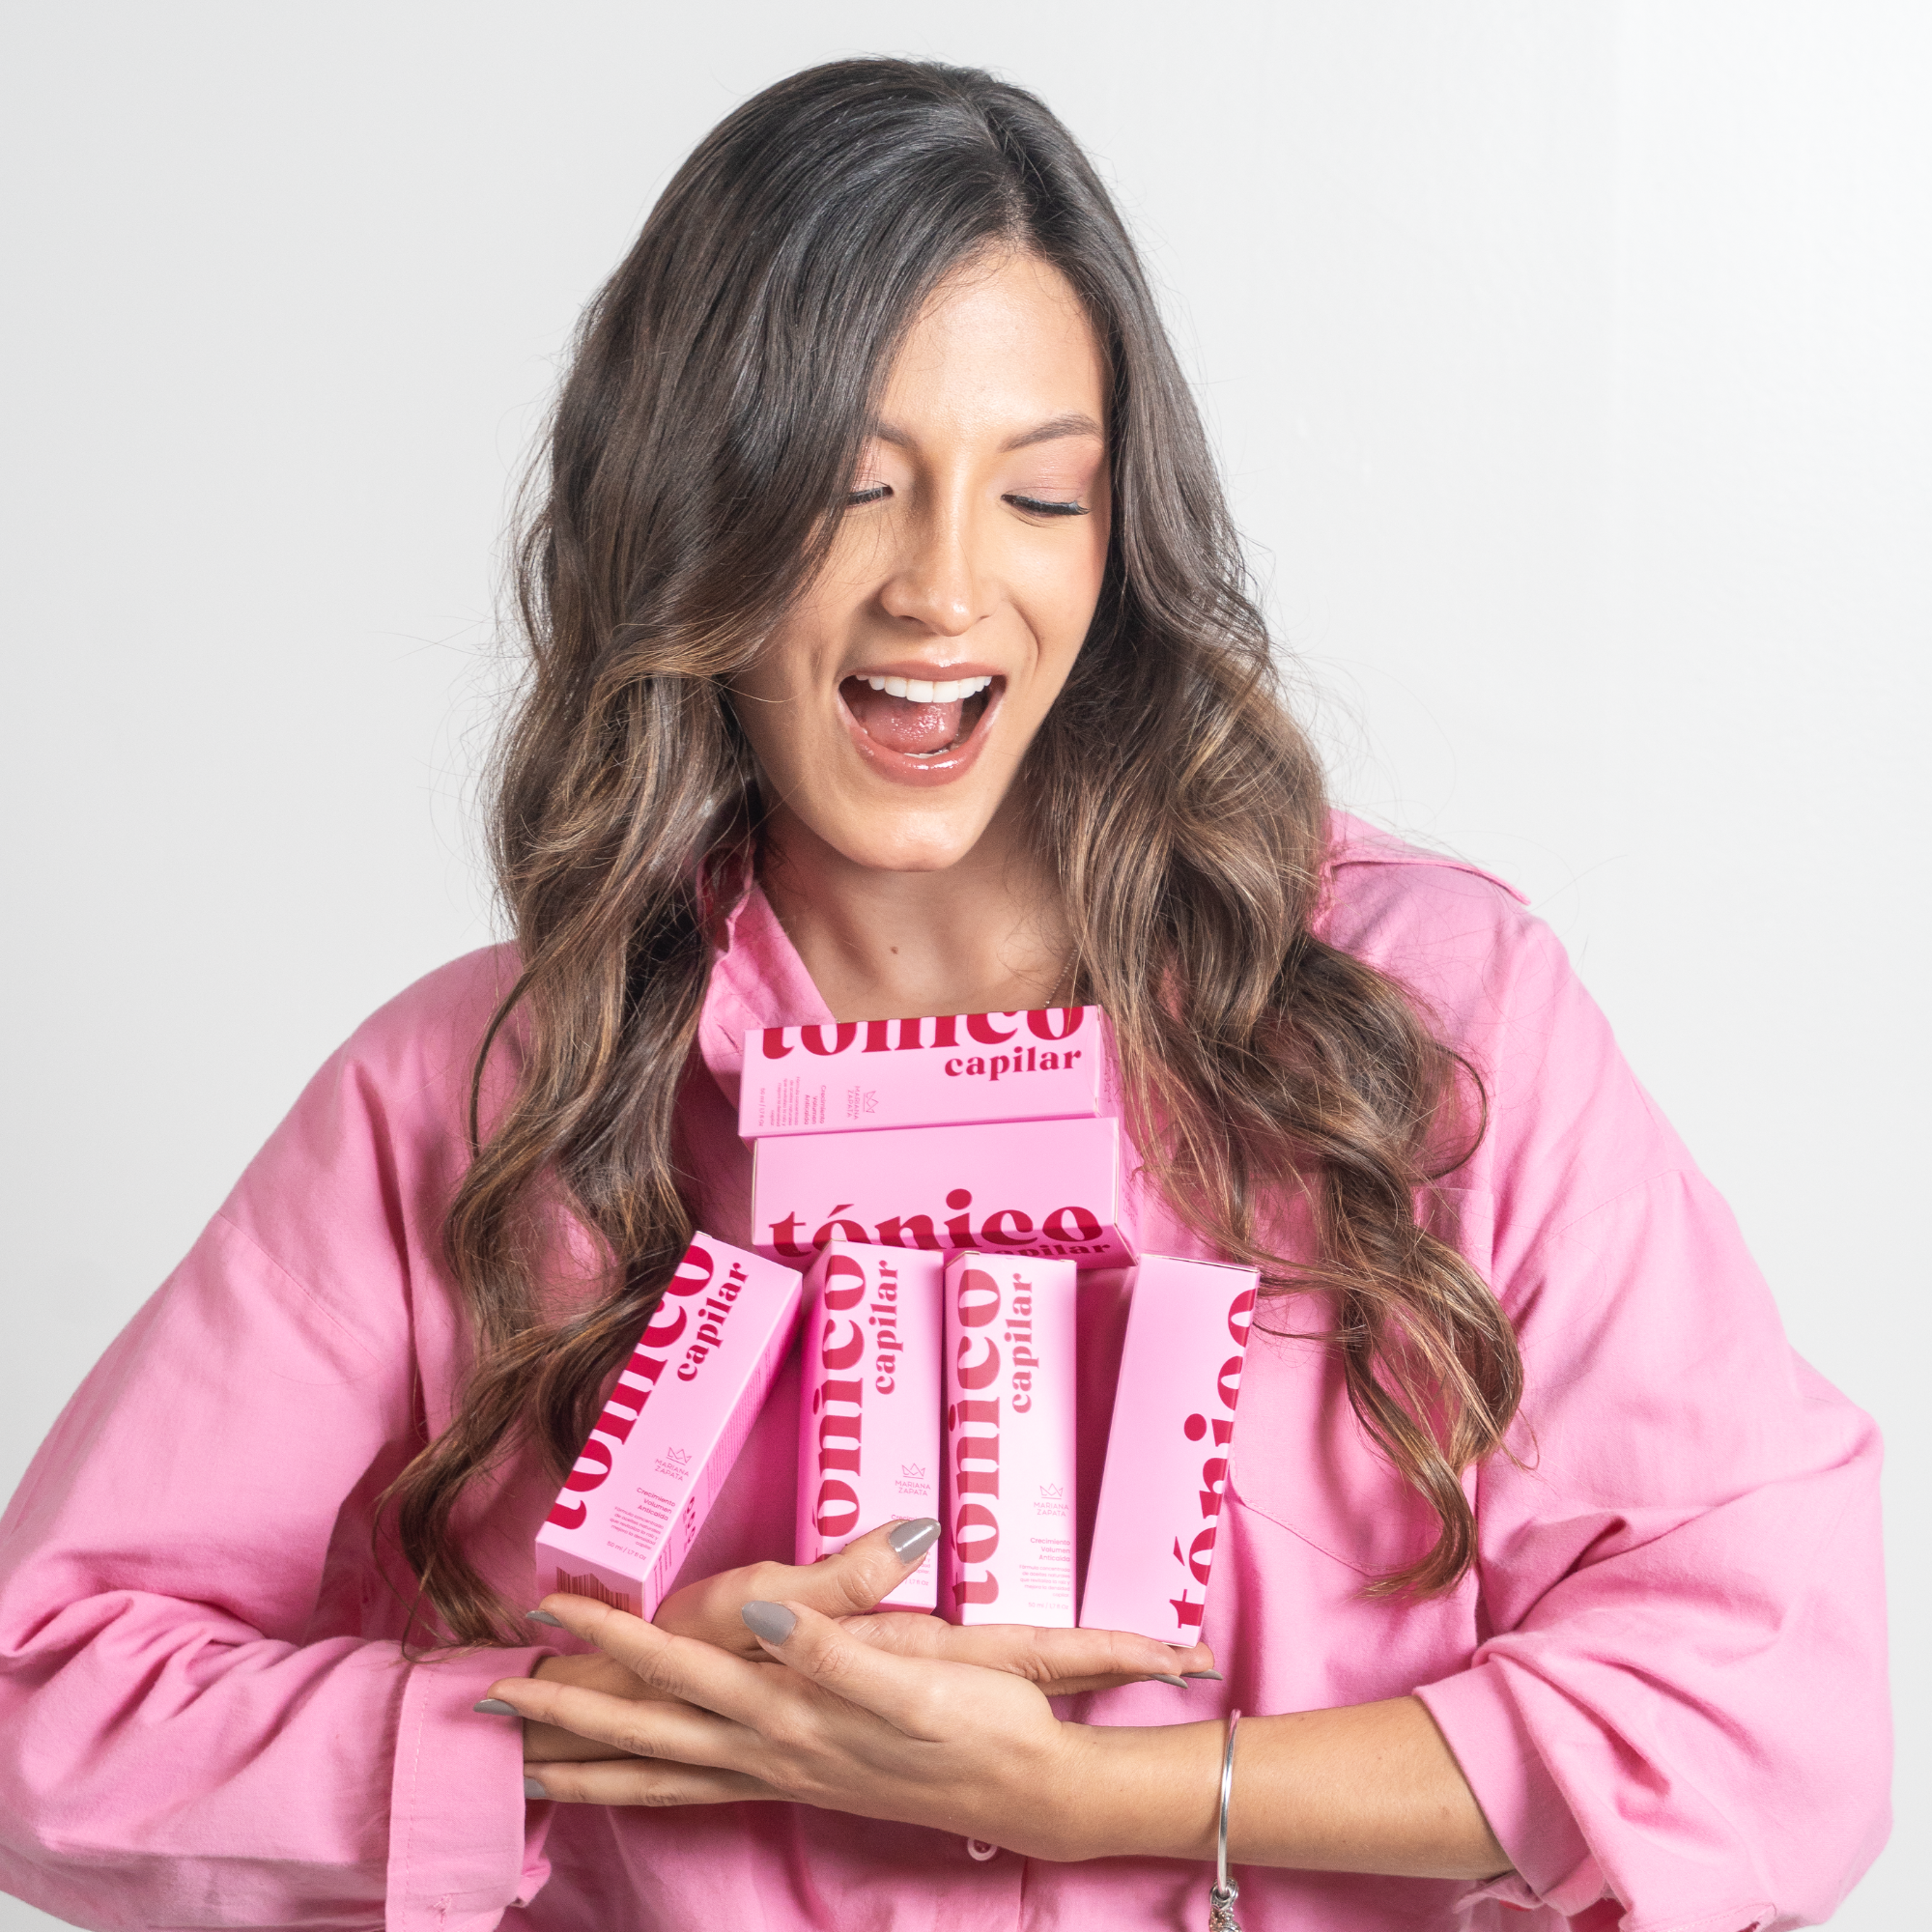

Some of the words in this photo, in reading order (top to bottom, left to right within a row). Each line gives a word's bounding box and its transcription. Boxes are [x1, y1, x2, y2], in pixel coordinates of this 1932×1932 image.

[944, 1045, 1082, 1081] capilar
[769, 1189, 1104, 1257] tónico
[676, 1262, 750, 1382] capilar
[869, 1260, 903, 1395] capilar
[1005, 1272, 1039, 1413] capilar
[655, 1459, 689, 1477] MARIANA
[655, 1464, 683, 1482] ZAPATA
[895, 1480, 931, 1490] MARIANA
[897, 1488, 928, 1496] ZAPATA
[637, 1487, 676, 1507] Crecimiento
[643, 1498, 672, 1514] Volumen
[1034, 1501, 1069, 1510] MARIANA
[1030, 1537, 1071, 1546] Crecimiento
